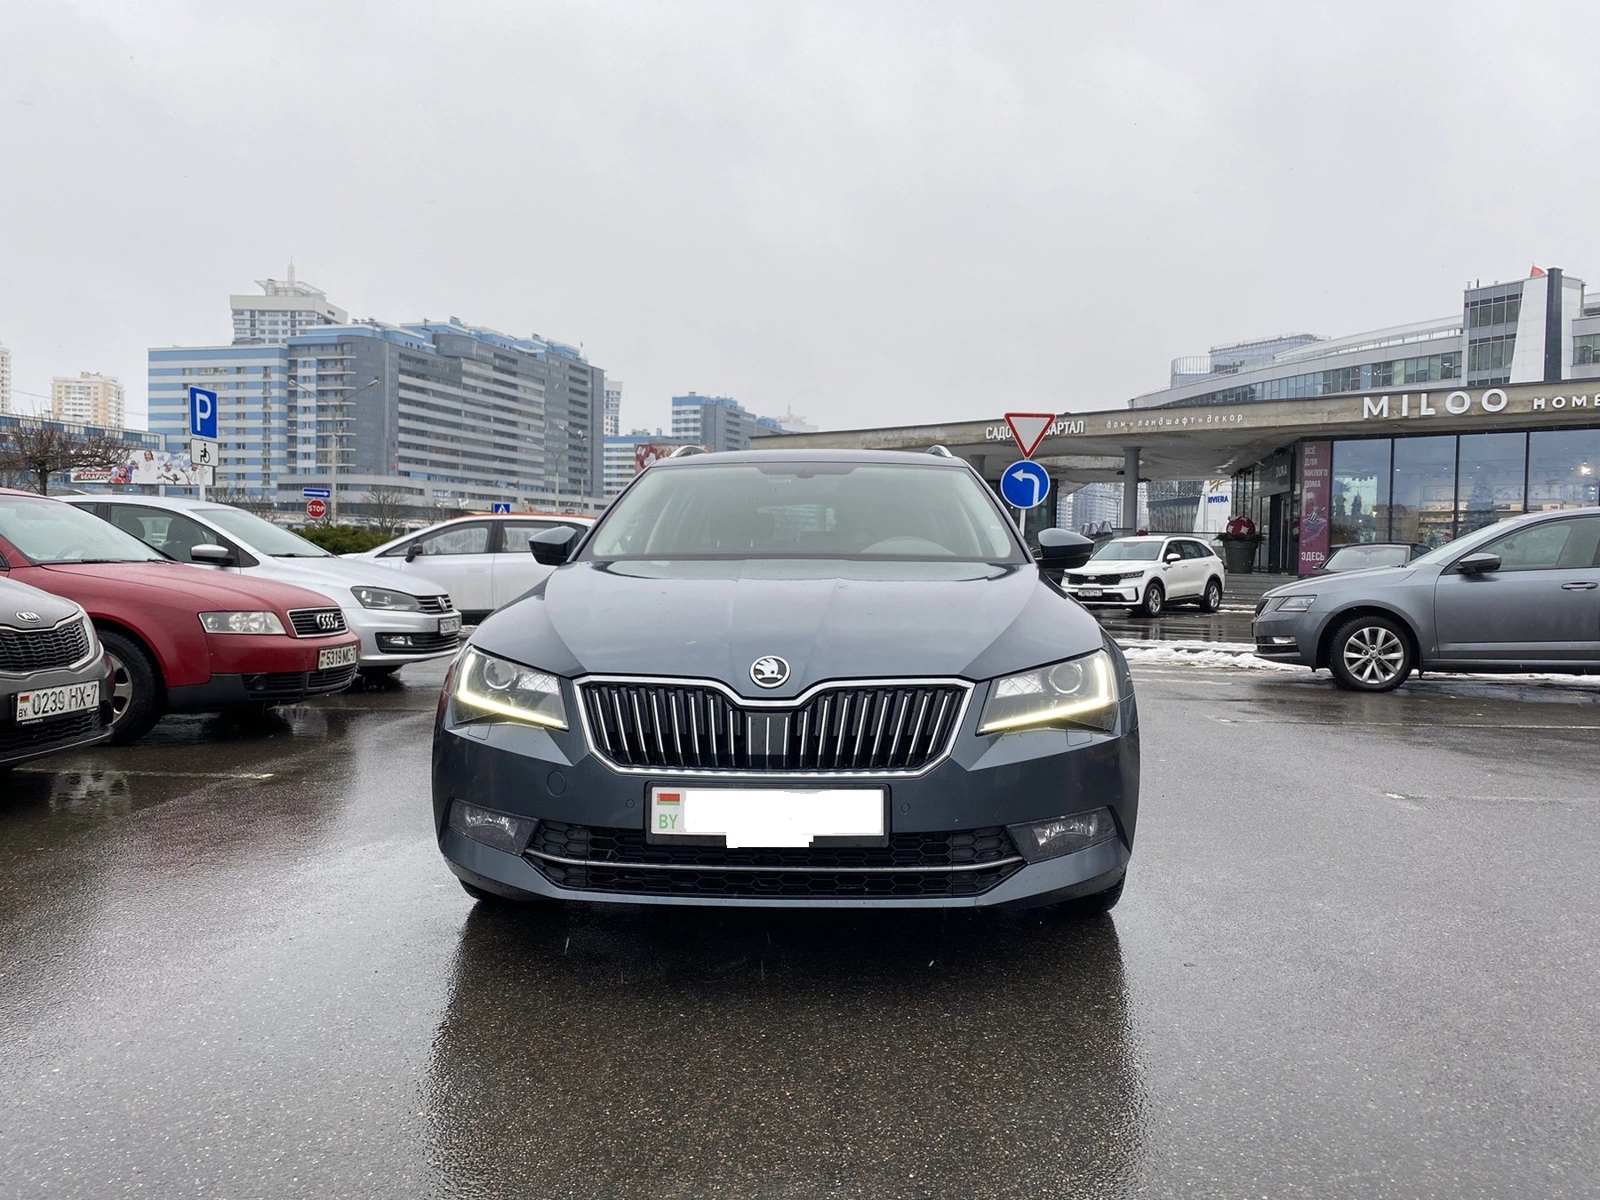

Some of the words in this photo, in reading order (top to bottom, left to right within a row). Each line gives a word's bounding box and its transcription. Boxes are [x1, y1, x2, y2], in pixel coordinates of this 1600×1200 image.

[1363, 388, 1508, 419] MILOO
[1533, 393, 1600, 410] HOME
[196, 393, 211, 431] P
[1137, 417, 1195, 426] ландшафт
[1206, 414, 1243, 423] декор
[986, 426, 1015, 440] САДО
[1045, 421, 1084, 436] АРТАЛ
[1304, 458, 1318, 466] ДЛЯ
[1304, 469, 1328, 477] МИЛОГО
[1304, 480, 1321, 488] ДОМА
[1301, 551, 1325, 561] ЗДЕСЬ
[32, 690, 65, 715] 0239
[68, 684, 97, 709] HX-7
[18, 707, 28, 717] BY
[658, 814, 678, 829] BY
